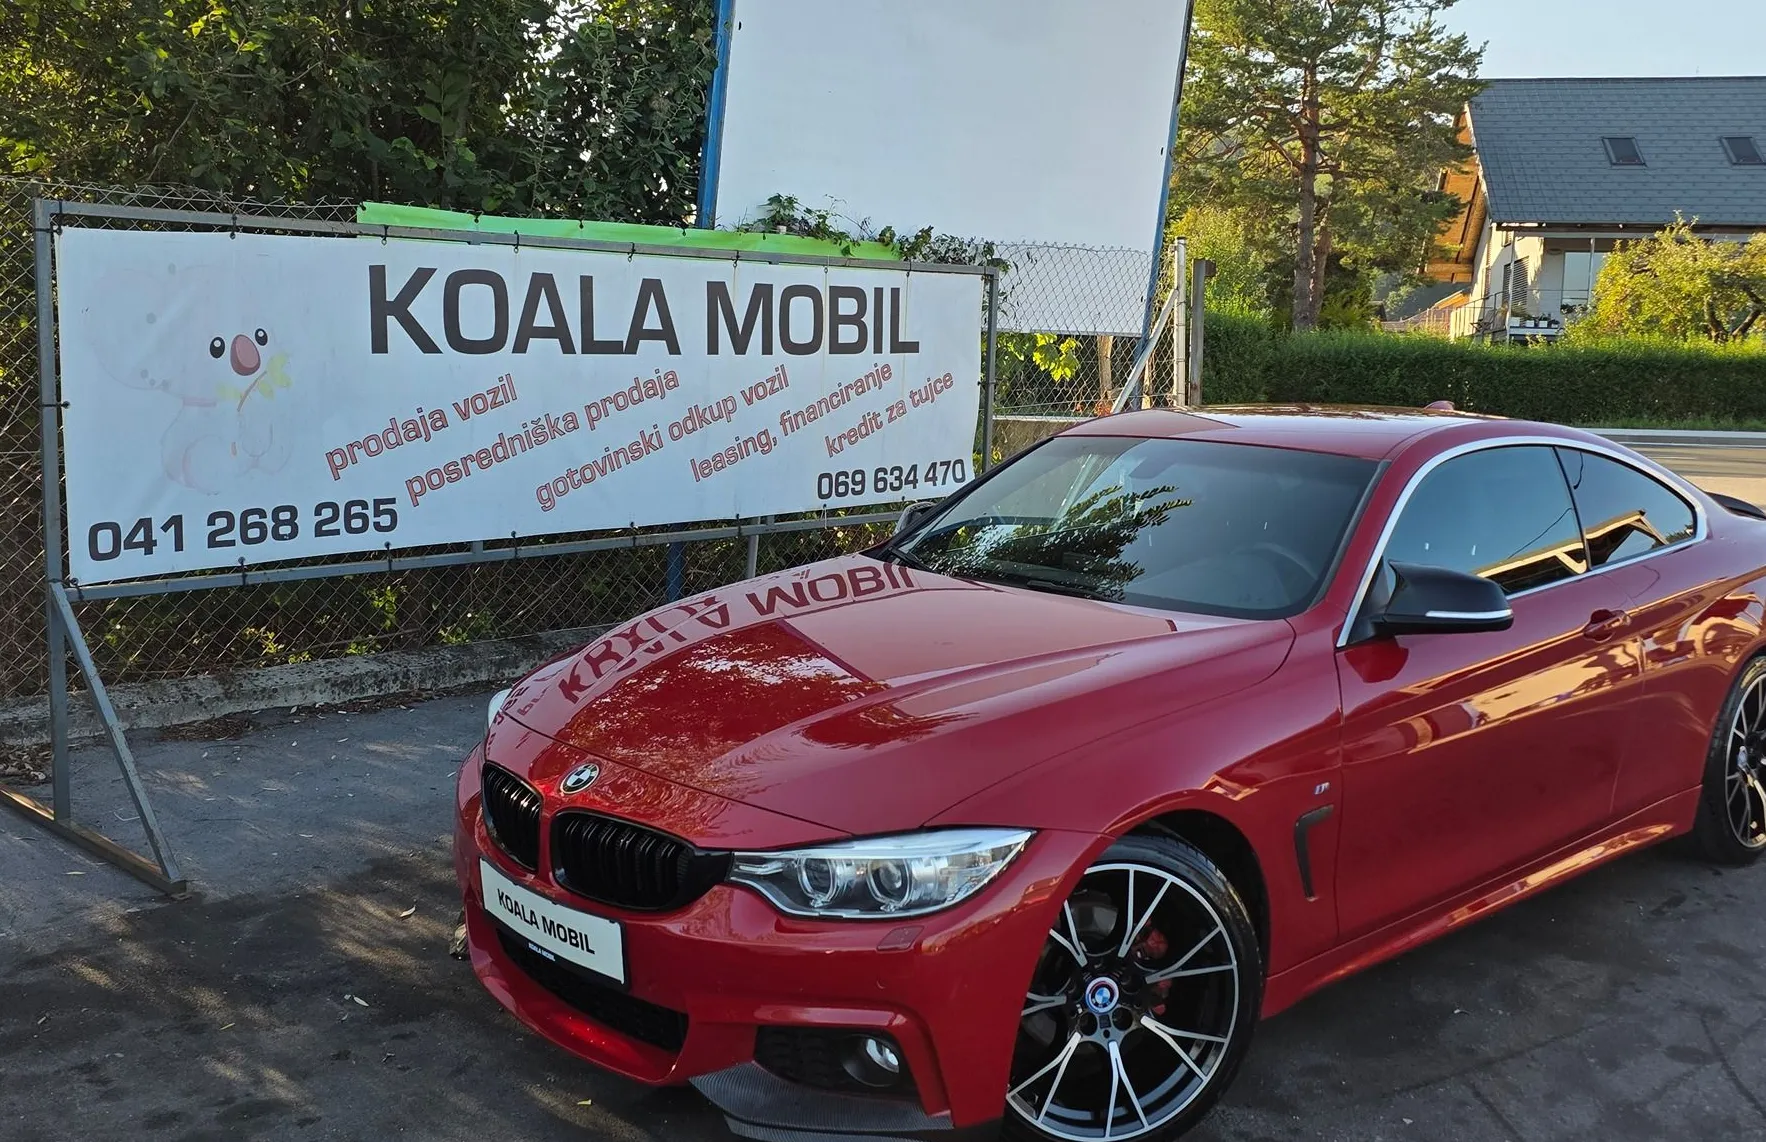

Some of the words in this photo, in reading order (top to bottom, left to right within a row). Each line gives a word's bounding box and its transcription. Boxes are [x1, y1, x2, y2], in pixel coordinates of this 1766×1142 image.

[369, 265, 681, 355] KOALA
[707, 281, 920, 355] MOBIL
[325, 408, 448, 481] prodaja
[452, 374, 518, 422] vozil
[405, 411, 579, 508] posredniška
[585, 368, 680, 431] prodaja
[536, 424, 665, 512] gotovinski
[669, 396, 737, 442] odkup
[740, 364, 790, 406] vozil
[690, 428, 778, 483] leasing,
[780, 362, 893, 438] financiranje
[825, 411, 883, 458] kredit
[886, 399, 907, 423] za
[909, 369, 954, 408] tujce
[818, 467, 866, 499] 069
[874, 464, 919, 493] 634
[924, 459, 966, 487] 470
[88, 514, 184, 561] 041
[207, 505, 299, 549] 268
[314, 497, 398, 538] 265
[497, 889, 539, 930] KOALA
[542, 916, 595, 954] MOBIL
